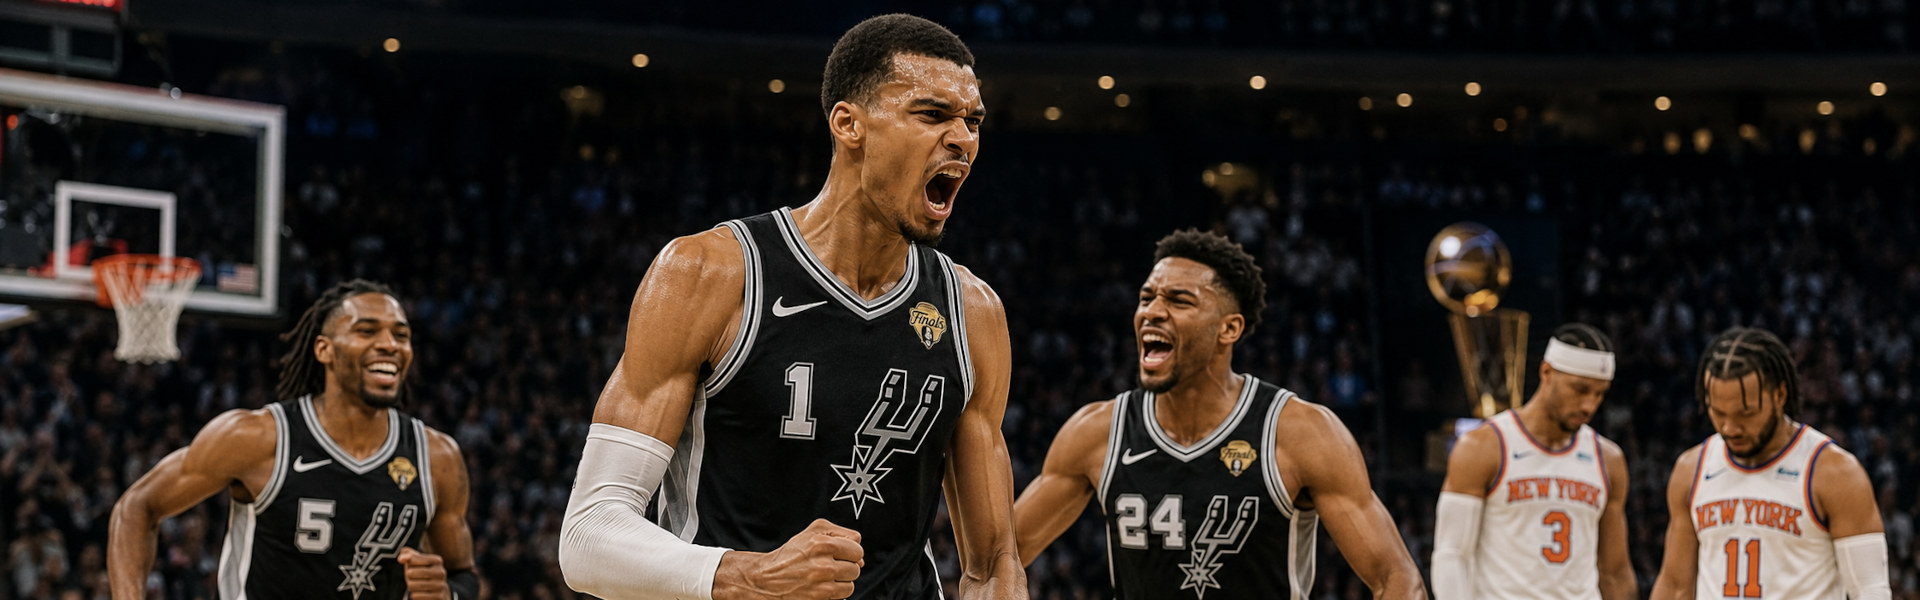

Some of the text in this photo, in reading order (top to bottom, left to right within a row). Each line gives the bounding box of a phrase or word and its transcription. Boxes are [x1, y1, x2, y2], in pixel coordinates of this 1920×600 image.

[911, 310, 944, 329] Finals
[779, 361, 817, 440] 1
[1507, 476, 1600, 511] NEW YORK
[1696, 498, 1802, 536] NEW YORK
[294, 497, 336, 554] 5
[1115, 494, 1187, 550] 24
[1541, 509, 1572, 564] 3
[1722, 538, 1762, 598] 11
